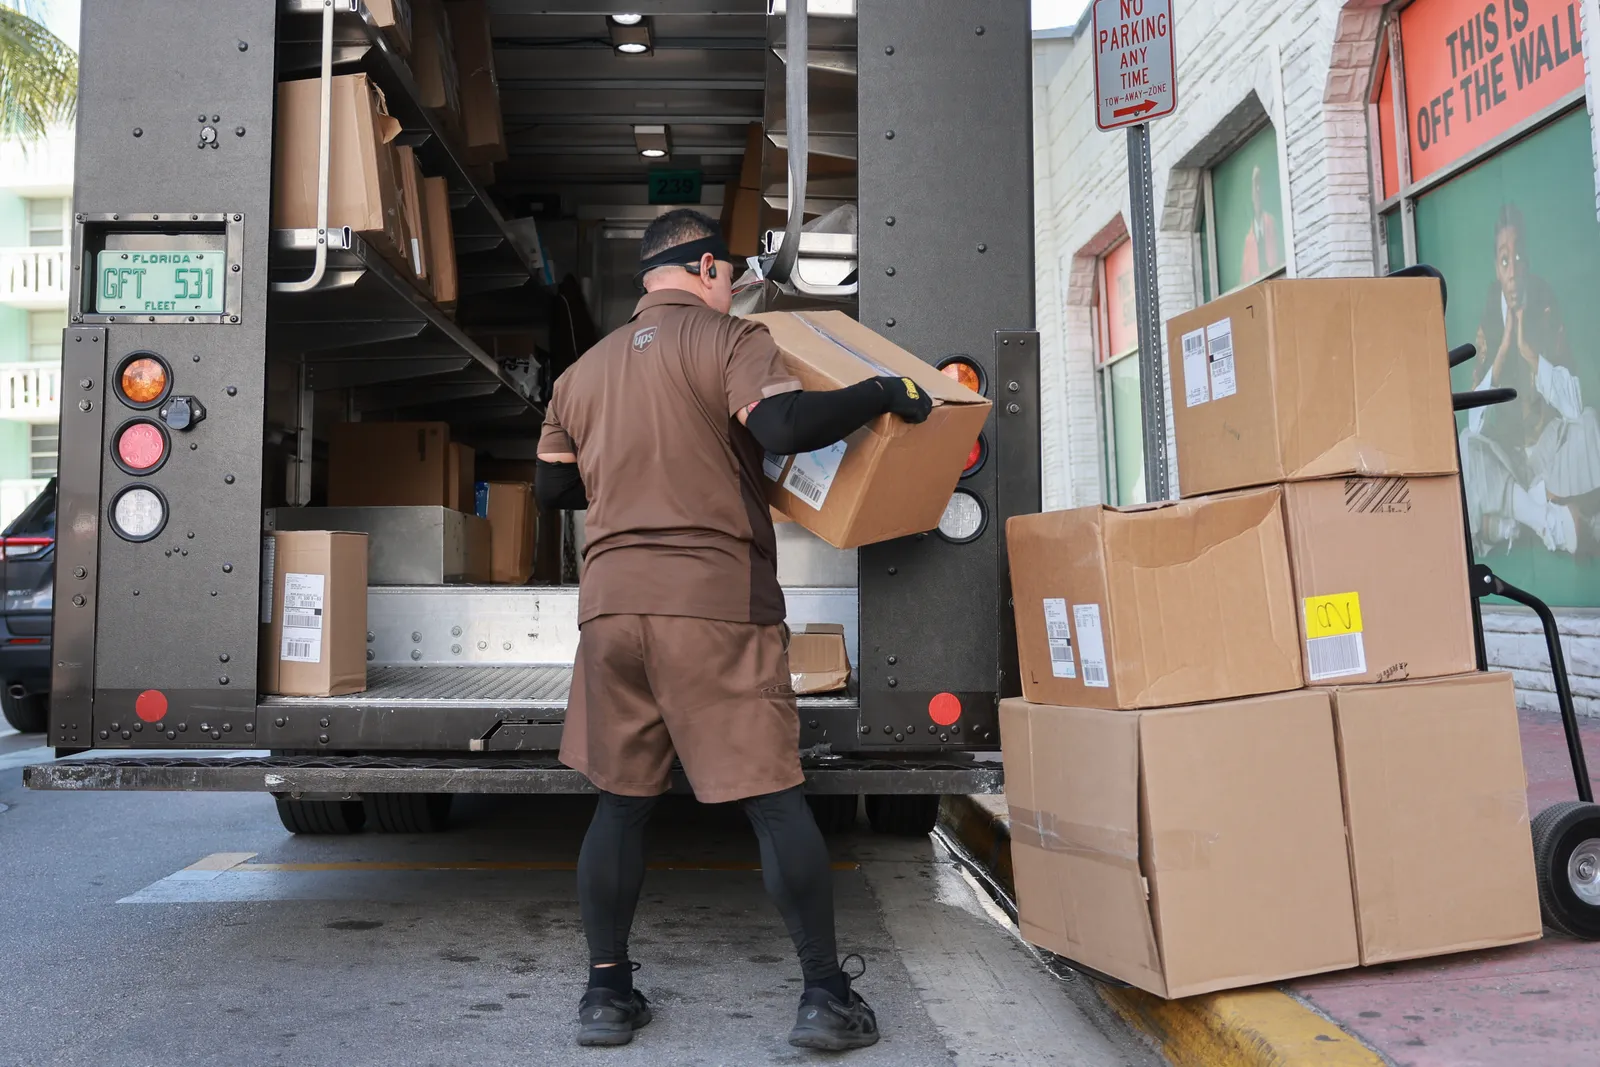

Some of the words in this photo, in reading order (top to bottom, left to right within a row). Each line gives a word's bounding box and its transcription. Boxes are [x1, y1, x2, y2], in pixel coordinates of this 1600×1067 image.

[1120, 0, 1143, 20] NO
[1100, 13, 1166, 54] PARKING
[1445, 3, 1499, 79] THIS
[1504, 0, 1529, 40] IS
[1120, 46, 1148, 69] ANY
[1120, 67, 1149, 90] TIME
[1417, 87, 1454, 151] OFF
[1460, 52, 1507, 123] THE
[1510, 3, 1582, 91] WALL
[132, 254, 191, 264] FLORIDA
[104, 267, 146, 299] GFT
[174, 267, 213, 299] 531
[145, 300, 176, 311] FLEET
[634, 332, 654, 349] ups
